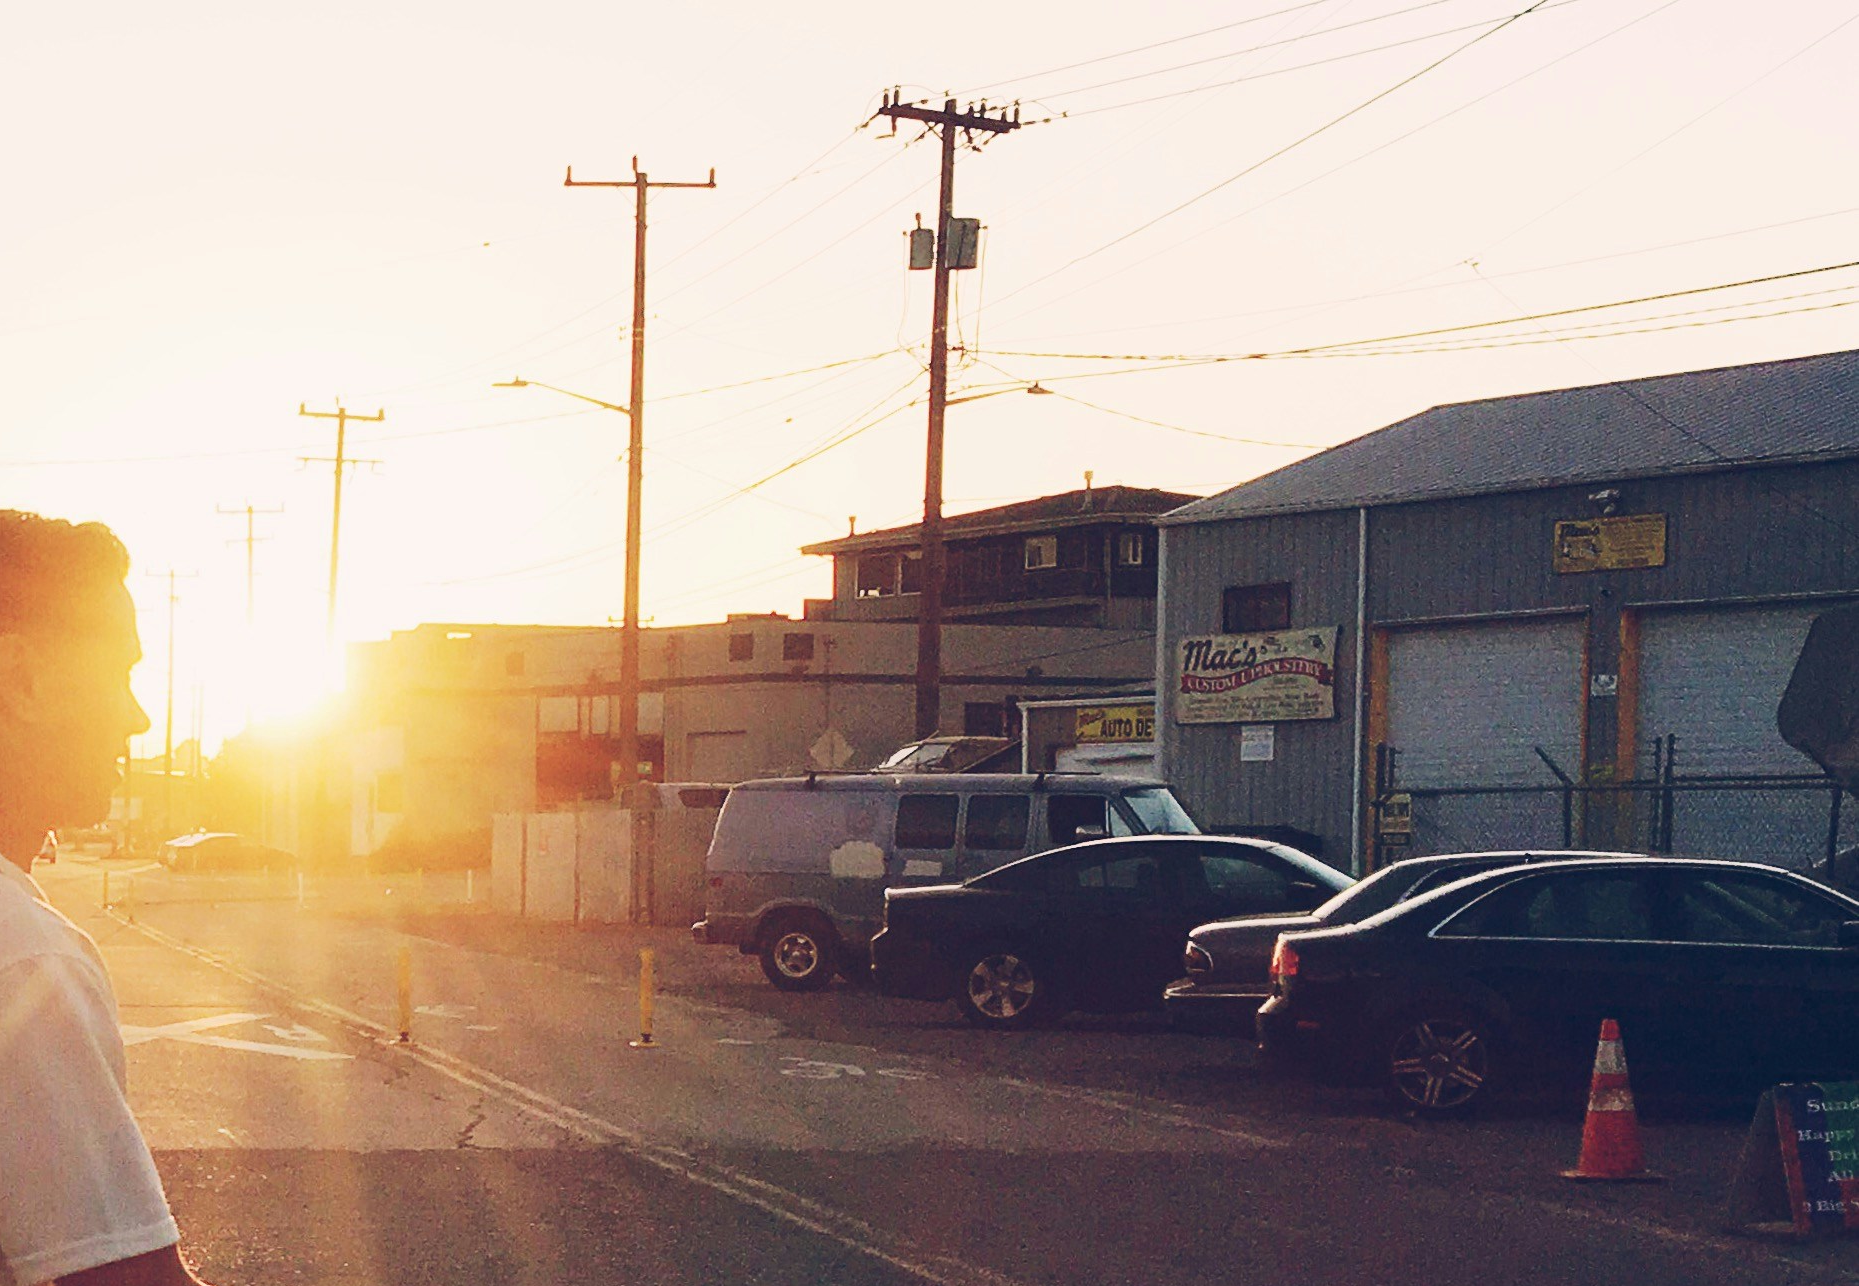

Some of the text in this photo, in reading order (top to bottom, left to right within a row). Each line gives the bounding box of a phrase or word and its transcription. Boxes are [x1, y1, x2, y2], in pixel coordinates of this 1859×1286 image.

[1183, 639, 1257, 671] Mac's
[1187, 674, 1236, 692] CUSTOM
[1100, 718, 1133, 738] AUTO
[1135, 717, 1155, 737] DE
